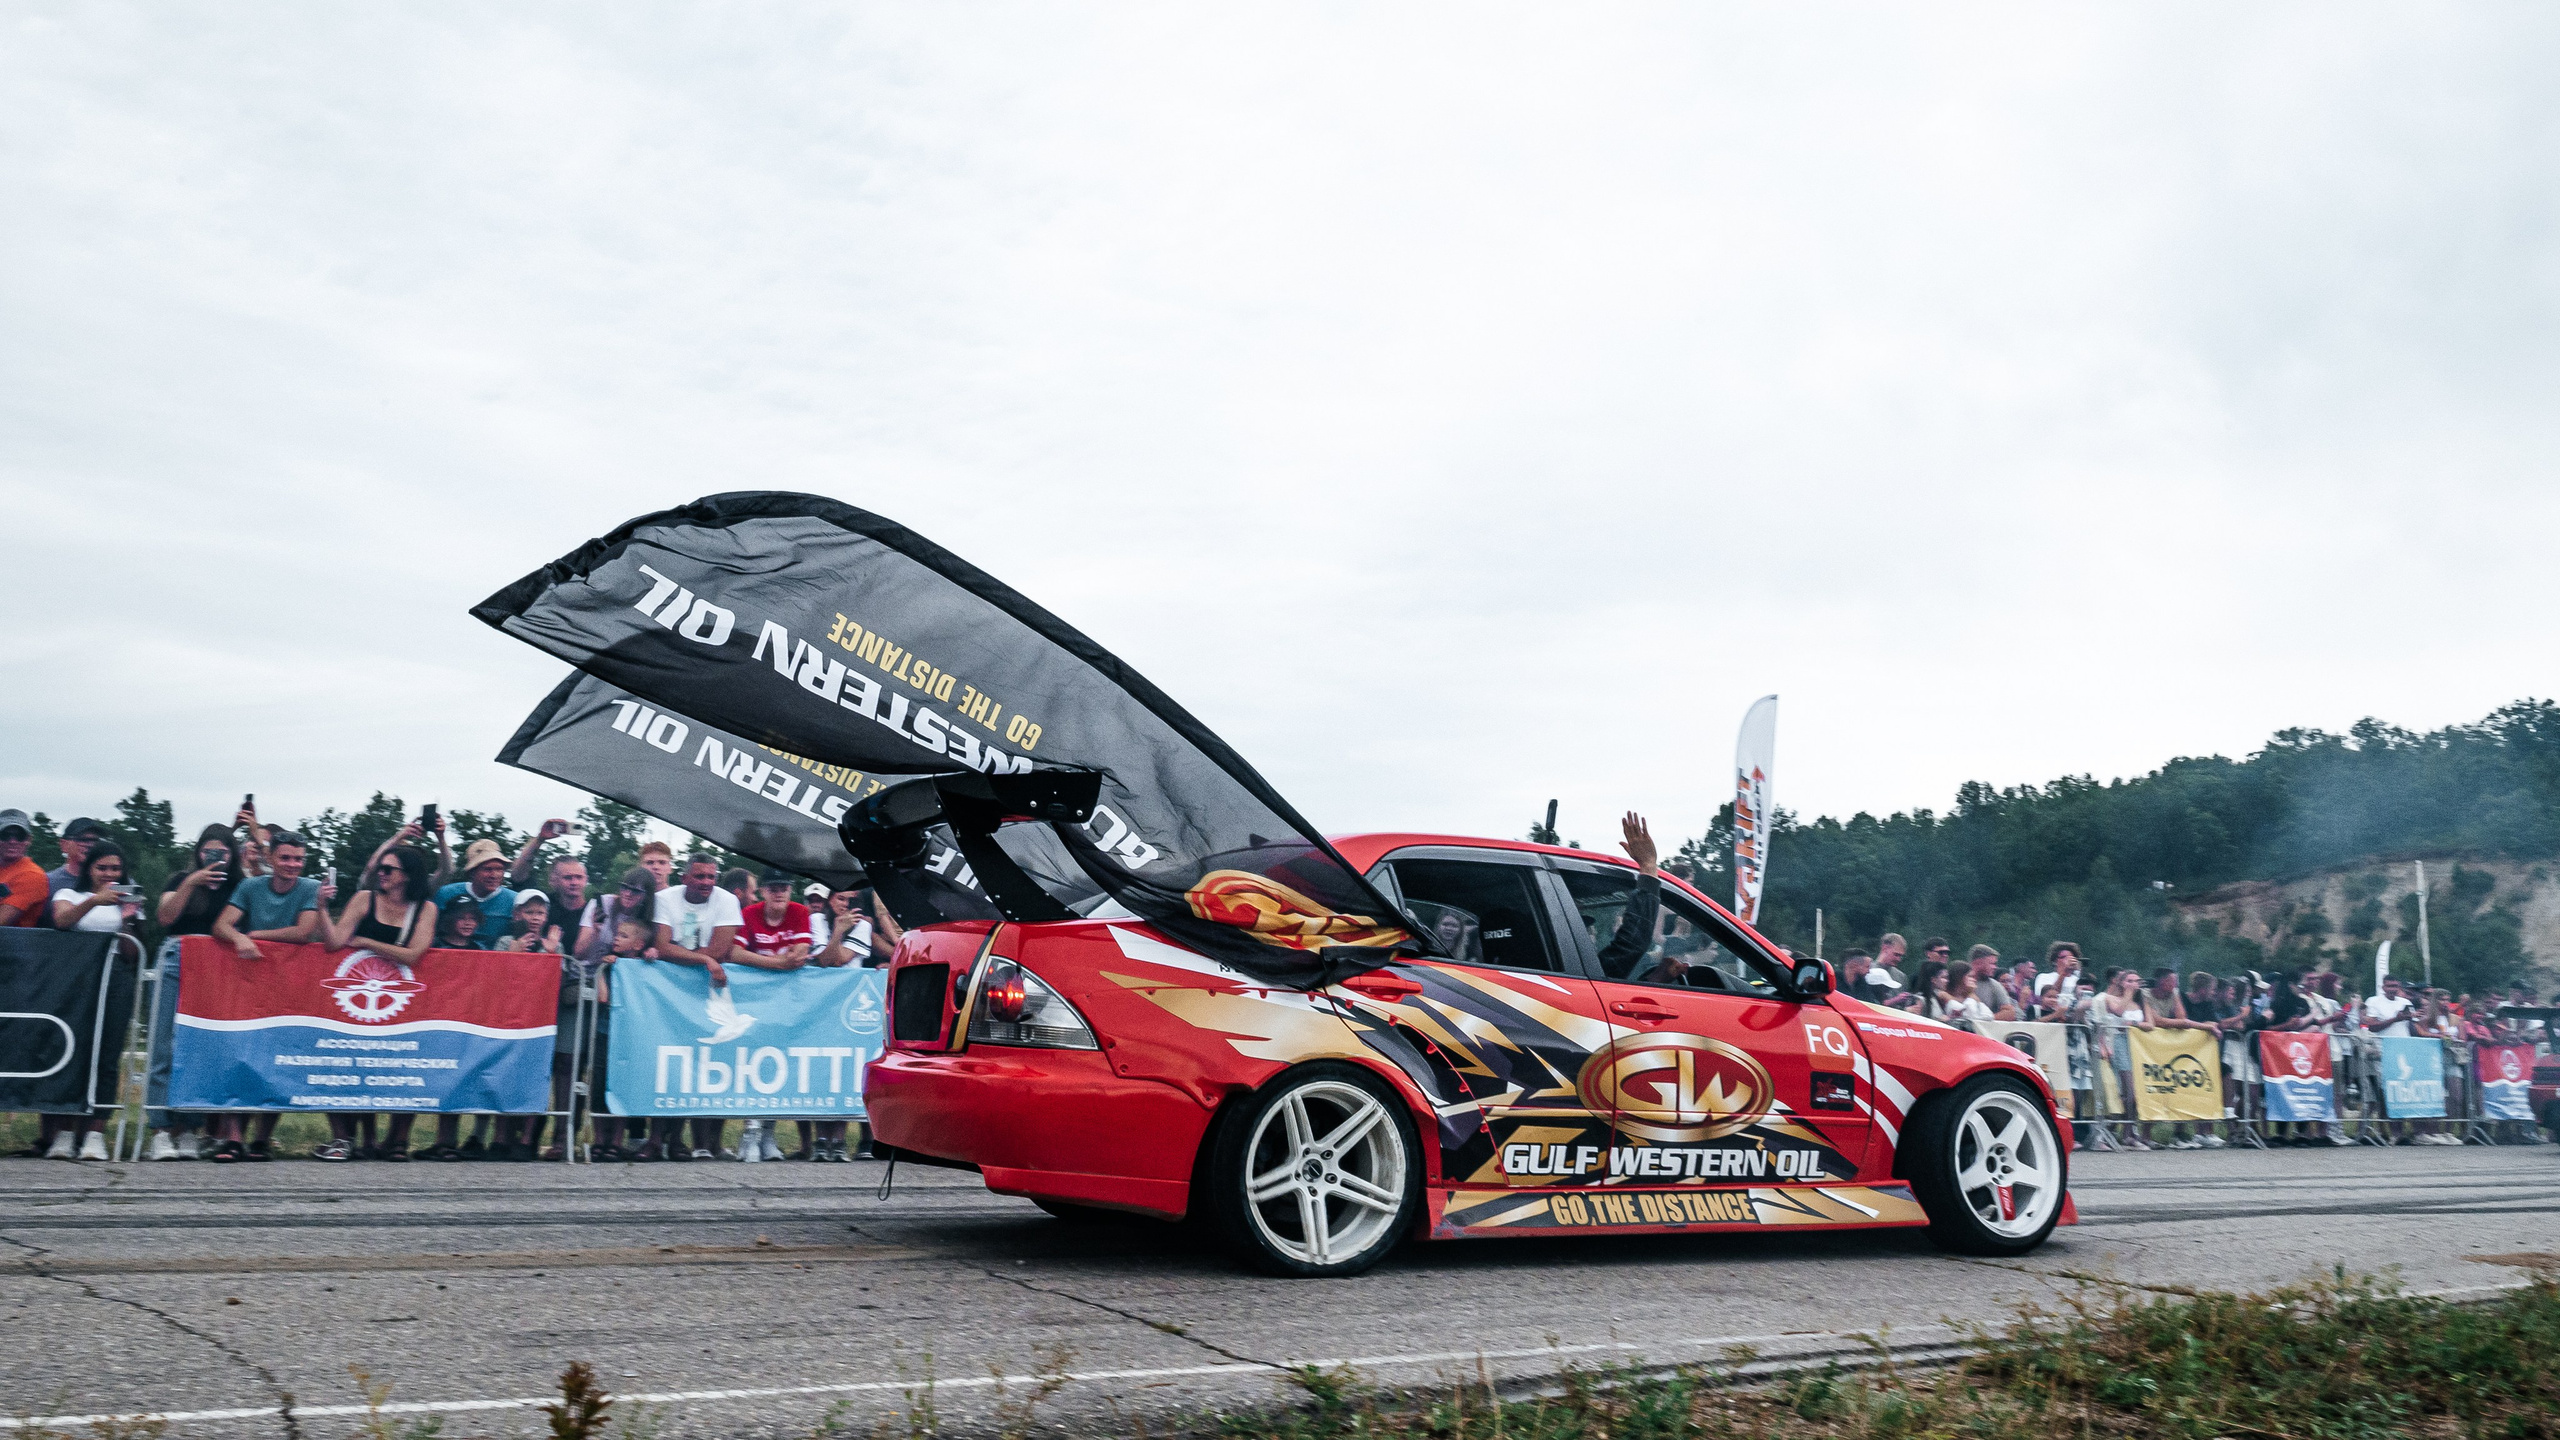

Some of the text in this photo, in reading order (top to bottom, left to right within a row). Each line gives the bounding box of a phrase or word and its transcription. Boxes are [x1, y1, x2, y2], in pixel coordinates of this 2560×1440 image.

[633, 564, 736, 646] OIL
[826, 612, 1043, 751] GO THE DISTANCE
[611, 699, 690, 753] OIL
[315, 1038, 419, 1051] АССОЦИАЦИЯ
[1804, 1024, 1849, 1056] FQ
[274, 1055, 459, 1069] РАЗВИТИЯ ТЕХНИЧЕСКИХ
[307, 1074, 426, 1087] ВИДОВ СПОРТА
[654, 1097, 836, 1109] СБАЛАНСИРОВАННАЯ
[1503, 1144, 1826, 1178] GULF WESTERN OIL
[1550, 1193, 1756, 1225] GO THE DISTANCE
